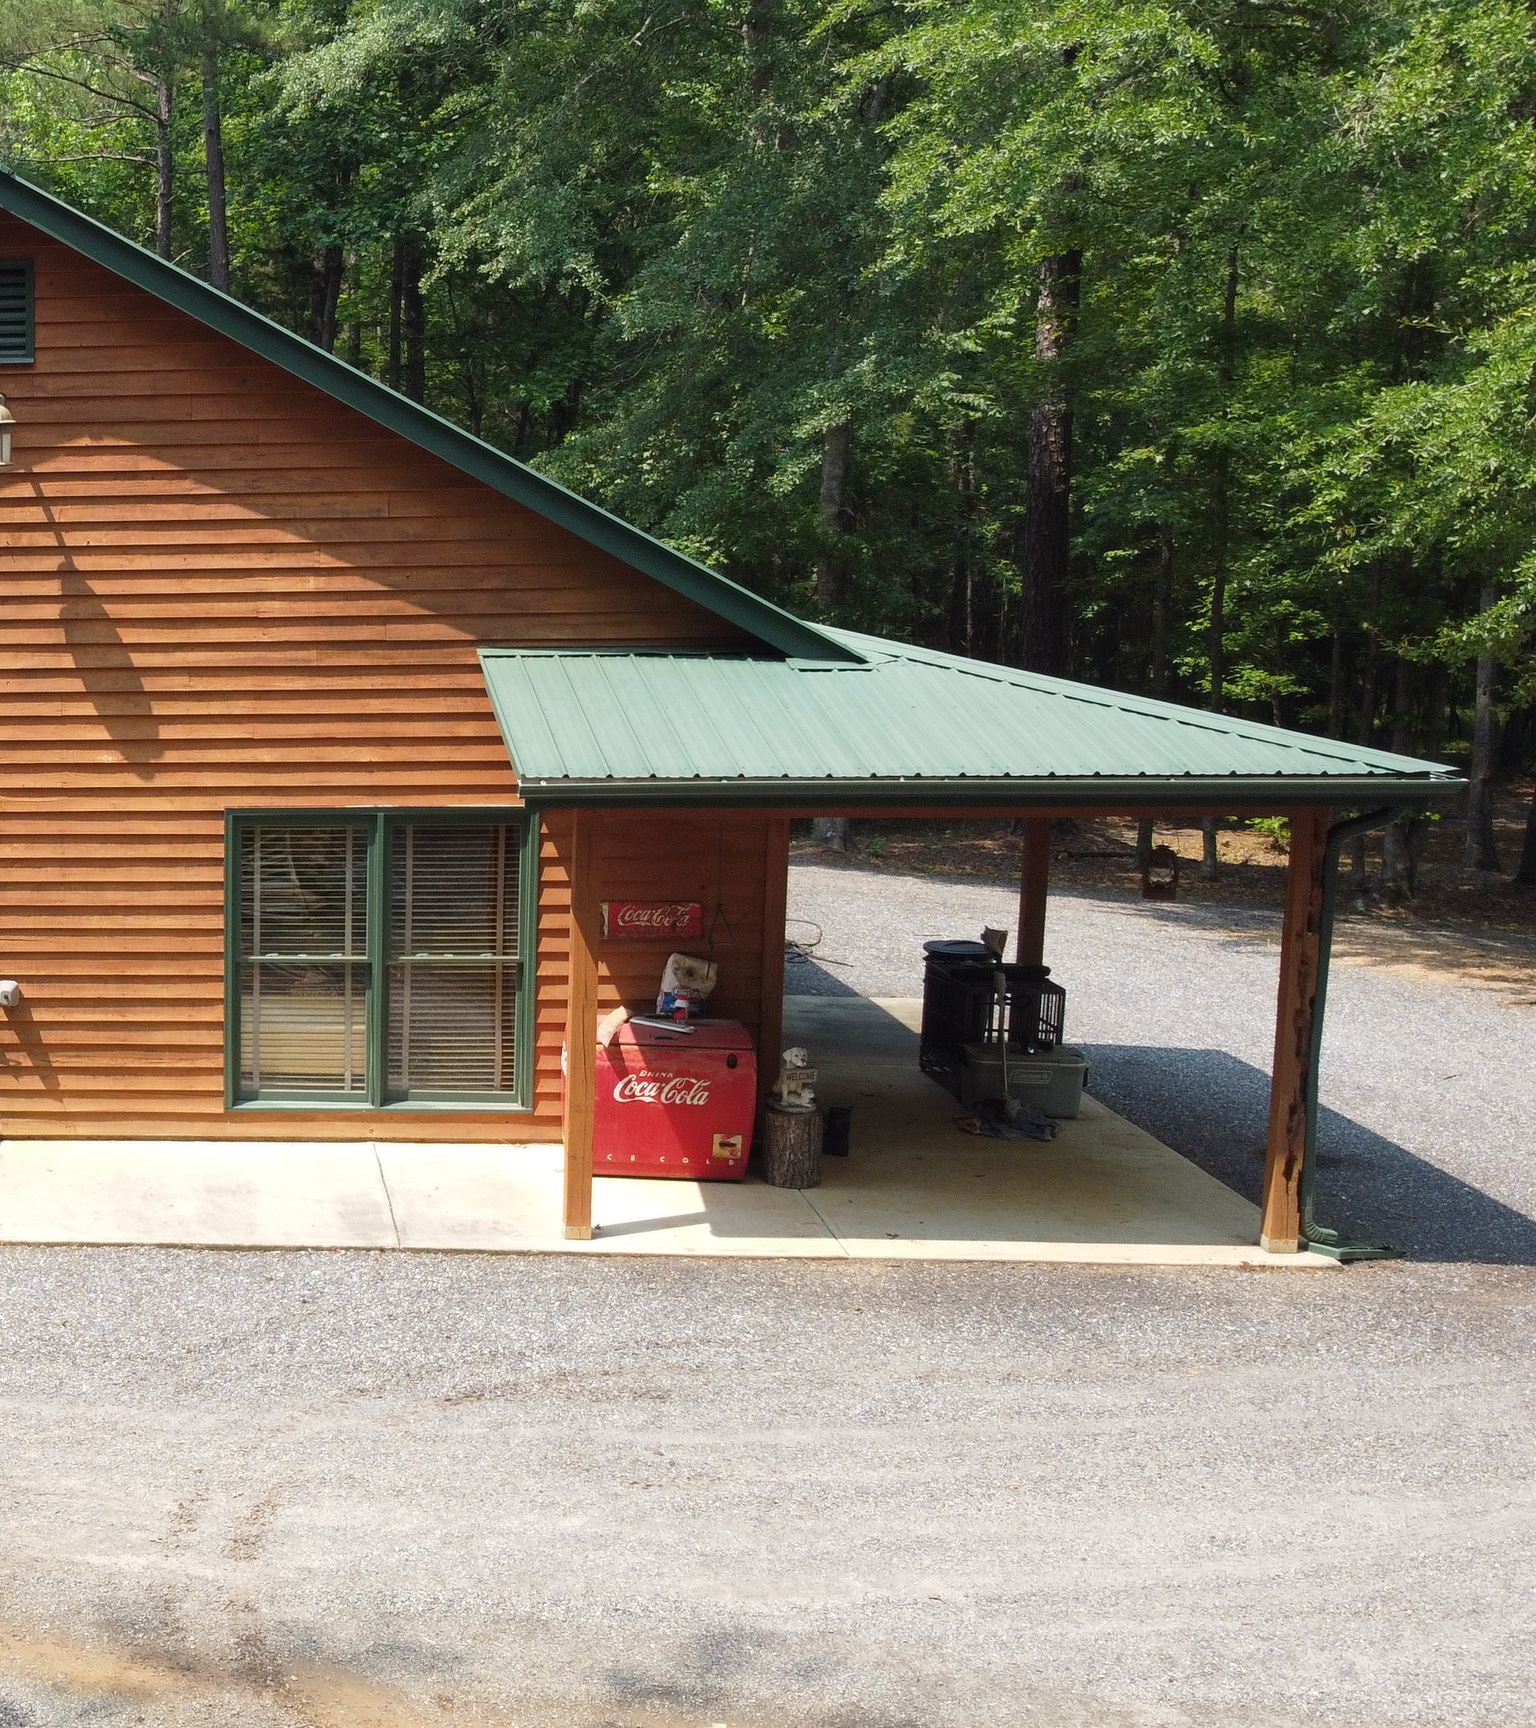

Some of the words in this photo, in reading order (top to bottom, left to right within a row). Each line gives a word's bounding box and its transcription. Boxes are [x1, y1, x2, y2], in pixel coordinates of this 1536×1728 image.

[639, 1070, 674, 1078] DRINK
[786, 1070, 816, 1081] WELCOME
[613, 1074, 711, 1105] Coca-Cola
[660, 1156, 734, 1166] COLD
